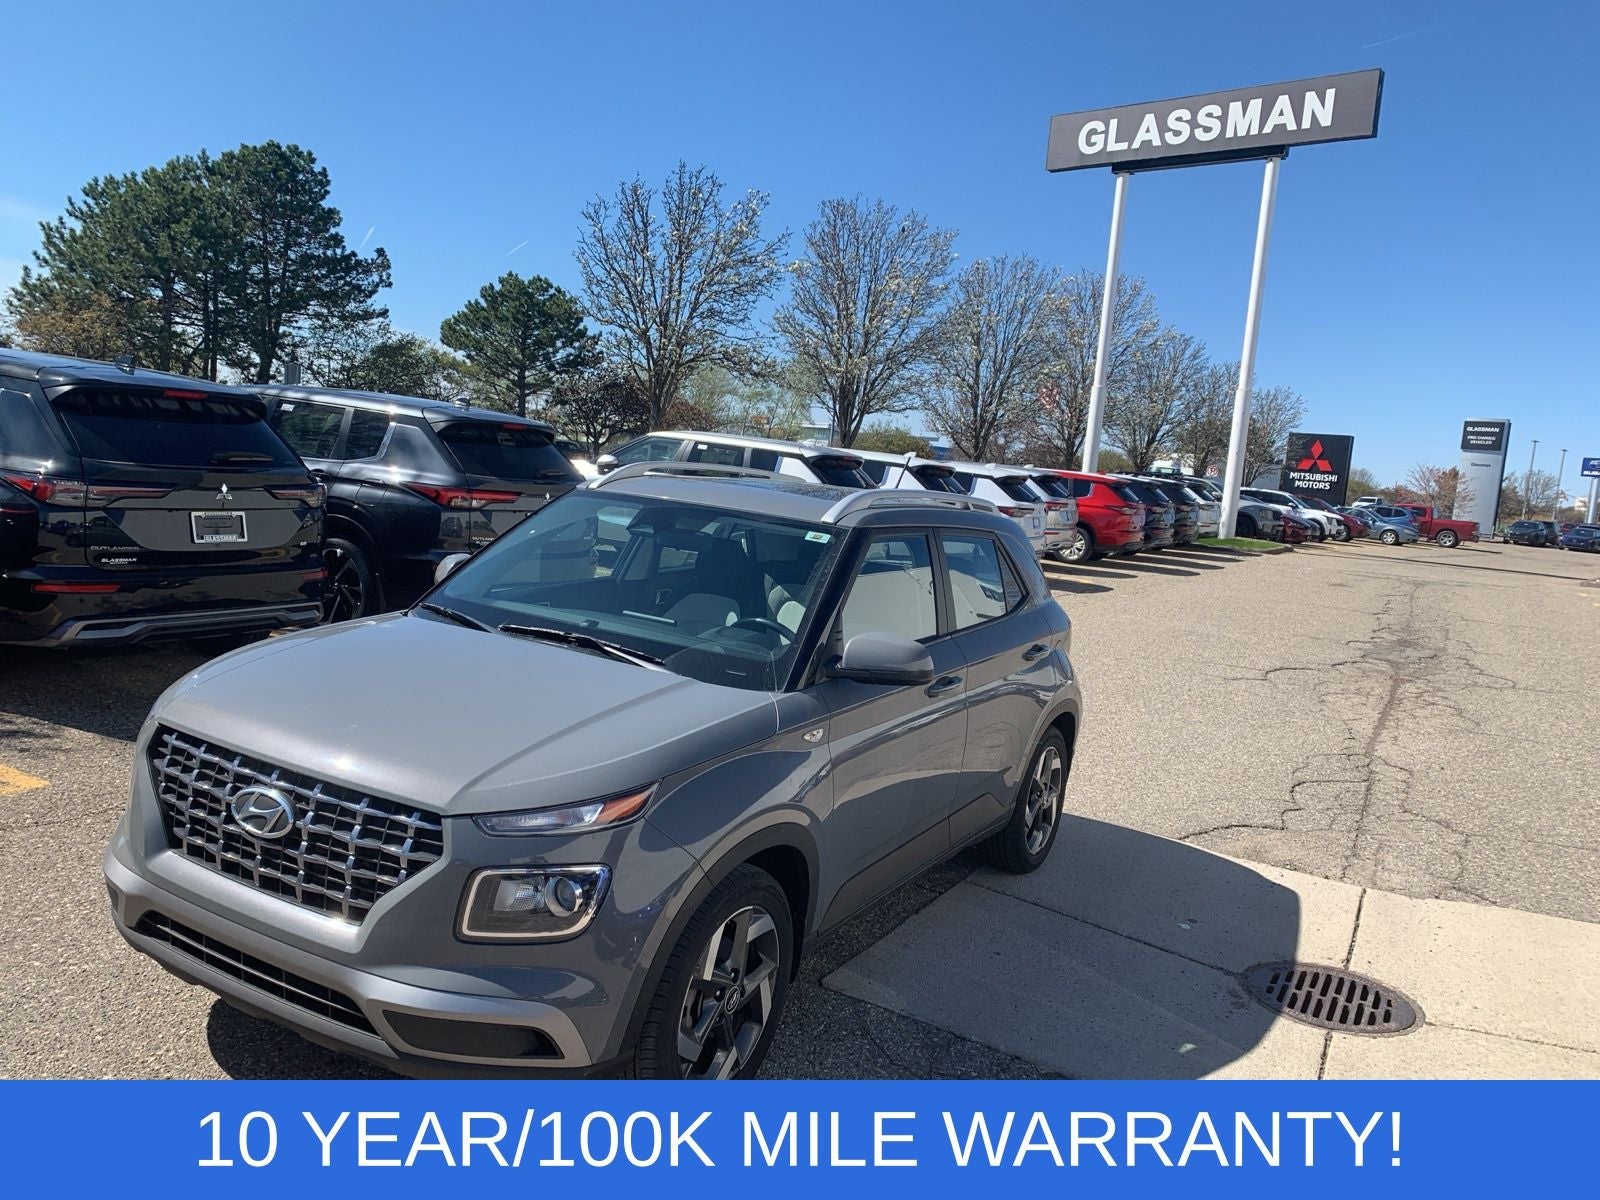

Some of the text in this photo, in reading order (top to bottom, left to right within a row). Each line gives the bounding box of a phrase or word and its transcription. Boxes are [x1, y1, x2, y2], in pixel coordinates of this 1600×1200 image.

[1077, 87, 1336, 155] GLASSMAN
[1289, 471, 1338, 483] MITSUBISHI
[1294, 480, 1331, 490] MOTORS
